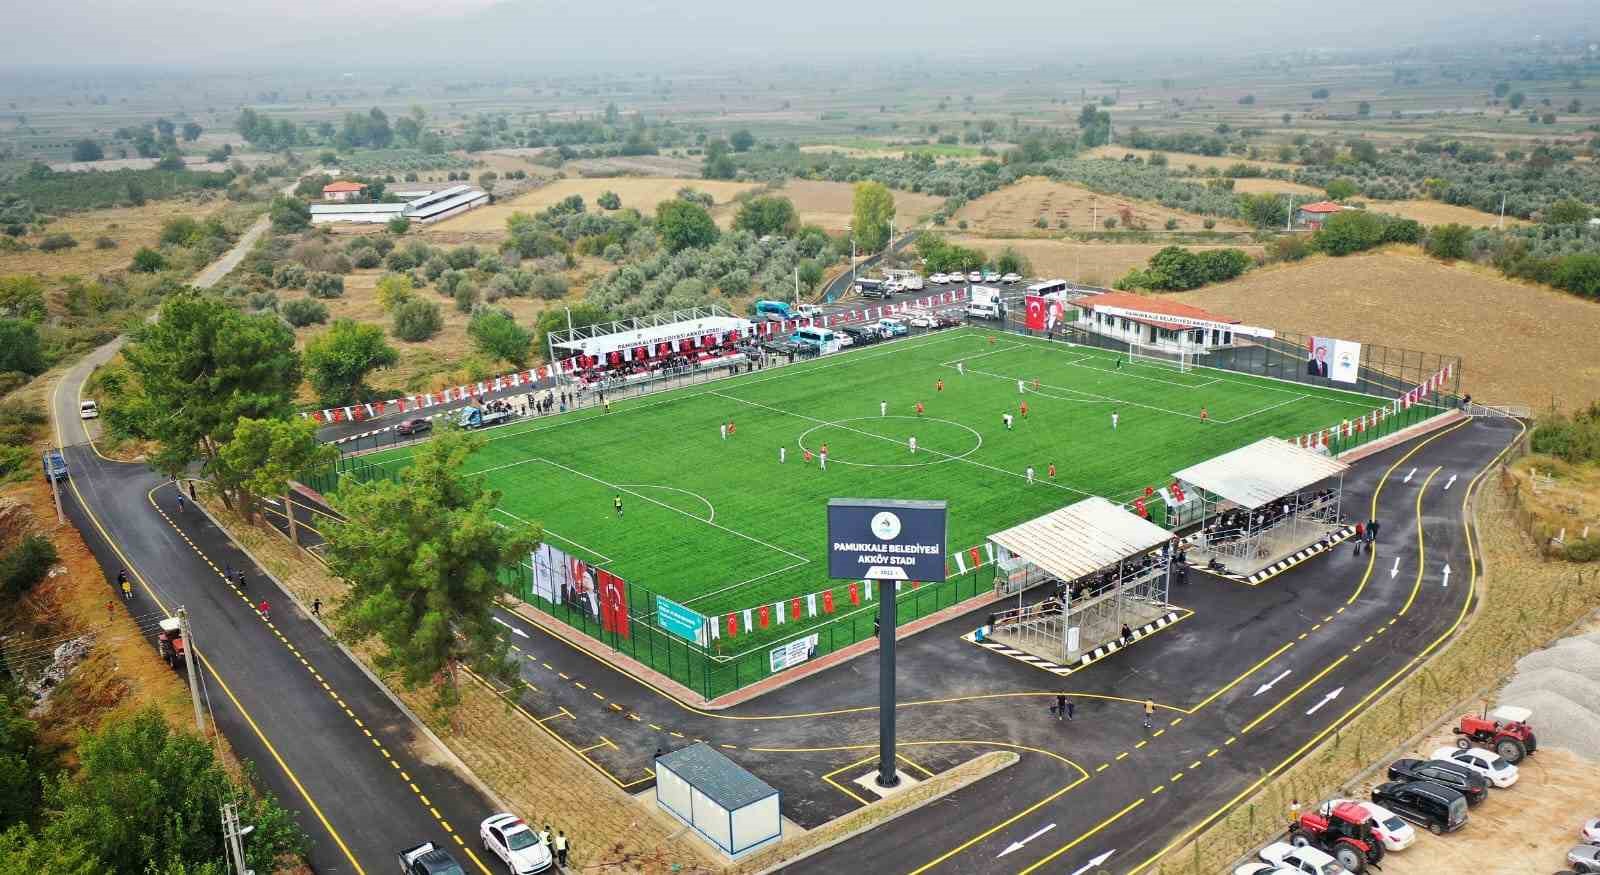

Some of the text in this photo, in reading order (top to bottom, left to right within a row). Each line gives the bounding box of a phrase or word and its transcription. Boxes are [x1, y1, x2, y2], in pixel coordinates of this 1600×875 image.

[834, 542, 939, 554] PAMUKKALE BELEDİYESİ
[858, 554, 916, 565] AKKÖY STADI
